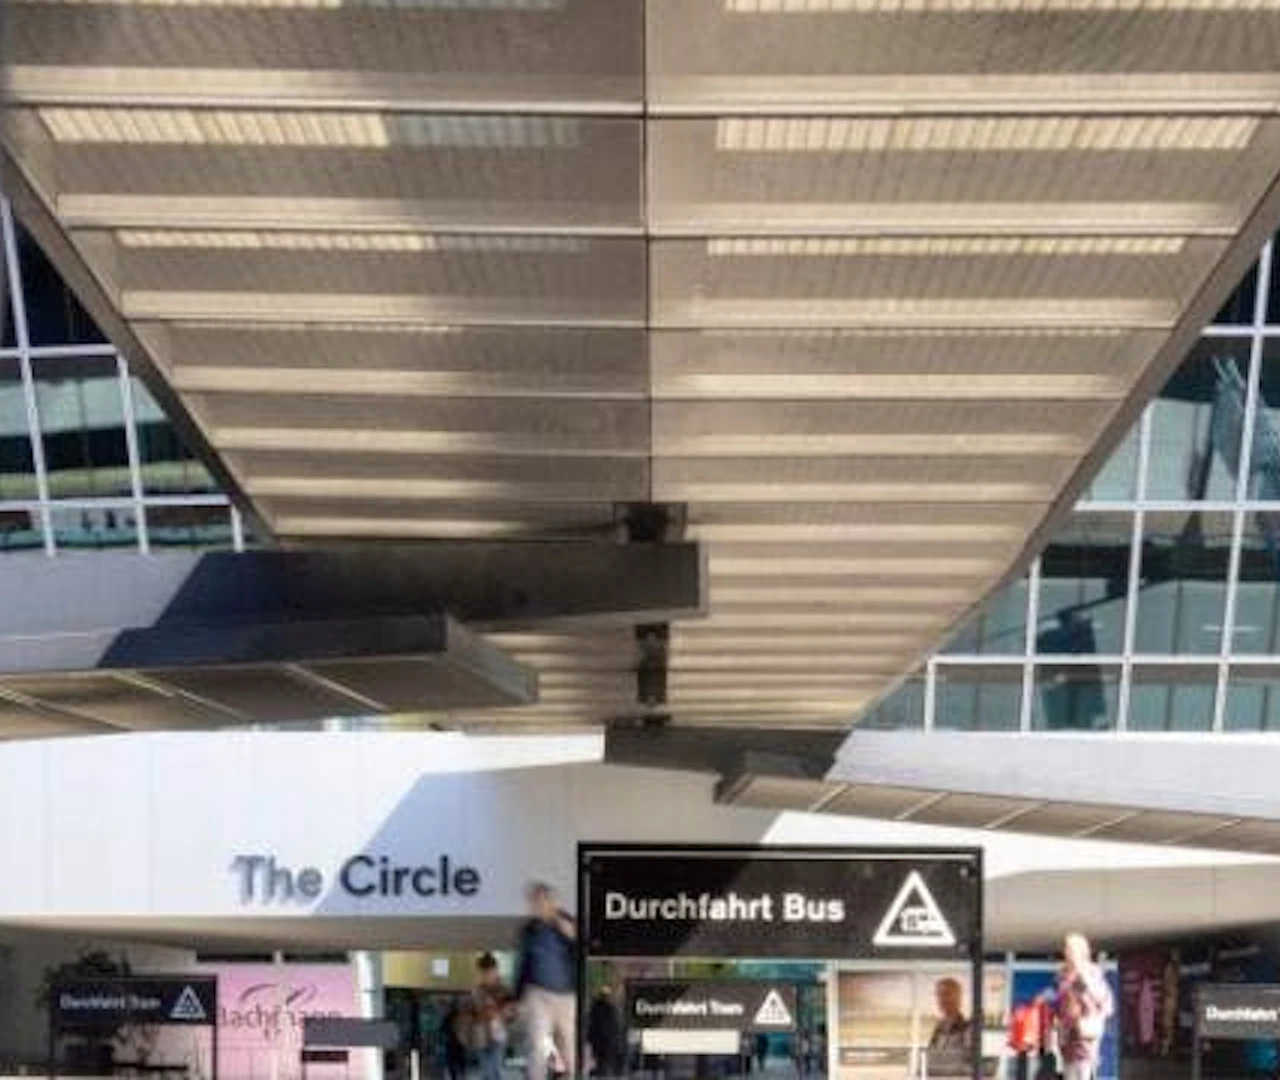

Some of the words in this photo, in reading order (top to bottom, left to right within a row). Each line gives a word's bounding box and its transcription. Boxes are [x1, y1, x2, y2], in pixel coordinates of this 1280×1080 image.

[232, 855, 324, 903] The
[339, 854, 482, 897] Circle
[605, 891, 773, 921] Durchfahrt
[783, 892, 846, 921] Bus
[635, 998, 707, 1016] Durchfahrt
[1206, 1005, 1277, 1022] Durchfahrt
